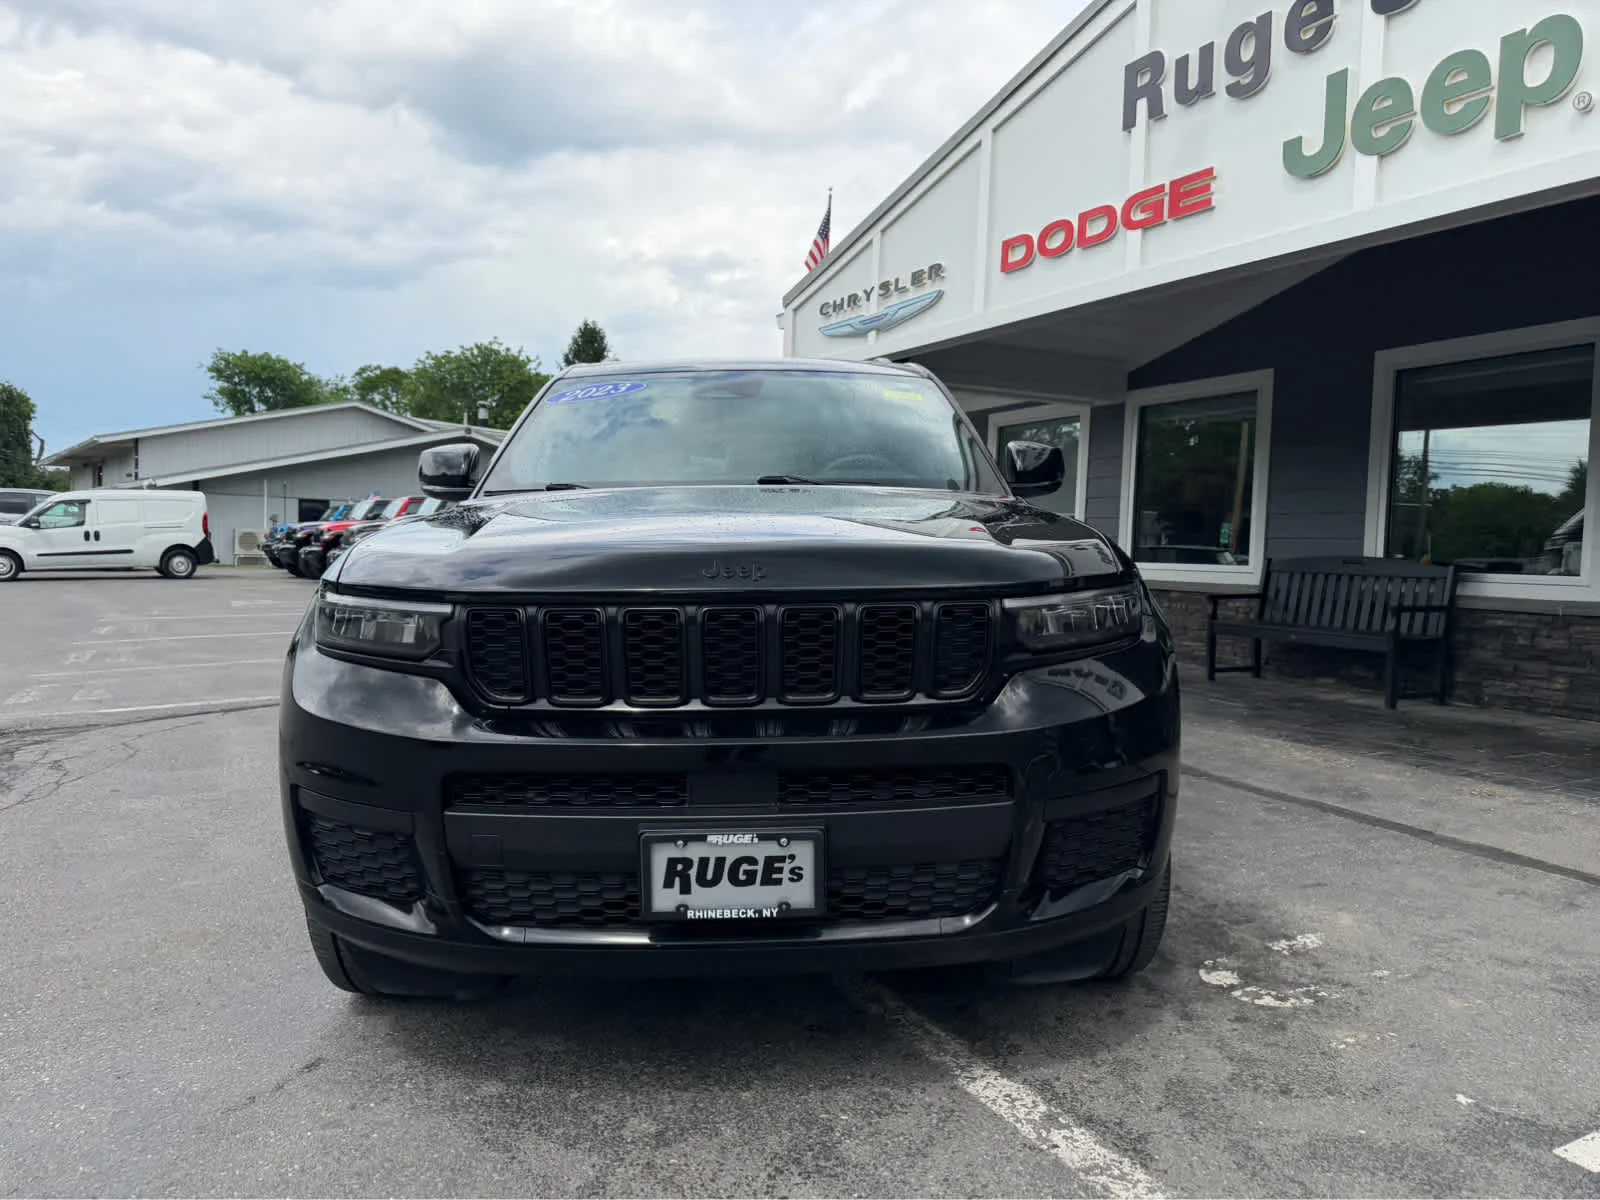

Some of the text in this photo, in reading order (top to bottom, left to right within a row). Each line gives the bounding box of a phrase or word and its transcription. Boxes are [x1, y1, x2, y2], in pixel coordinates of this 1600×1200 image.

[1122, 0, 1420, 133] Ruge
[1282, 13, 1584, 179] Jeep
[1000, 166, 1217, 273] DODGE
[819, 262, 946, 317] CHRYSLER
[562, 382, 631, 401] 2023
[702, 559, 768, 583] Jeep
[662, 853, 804, 895] RUGE's
[762, 907, 778, 918] NY
